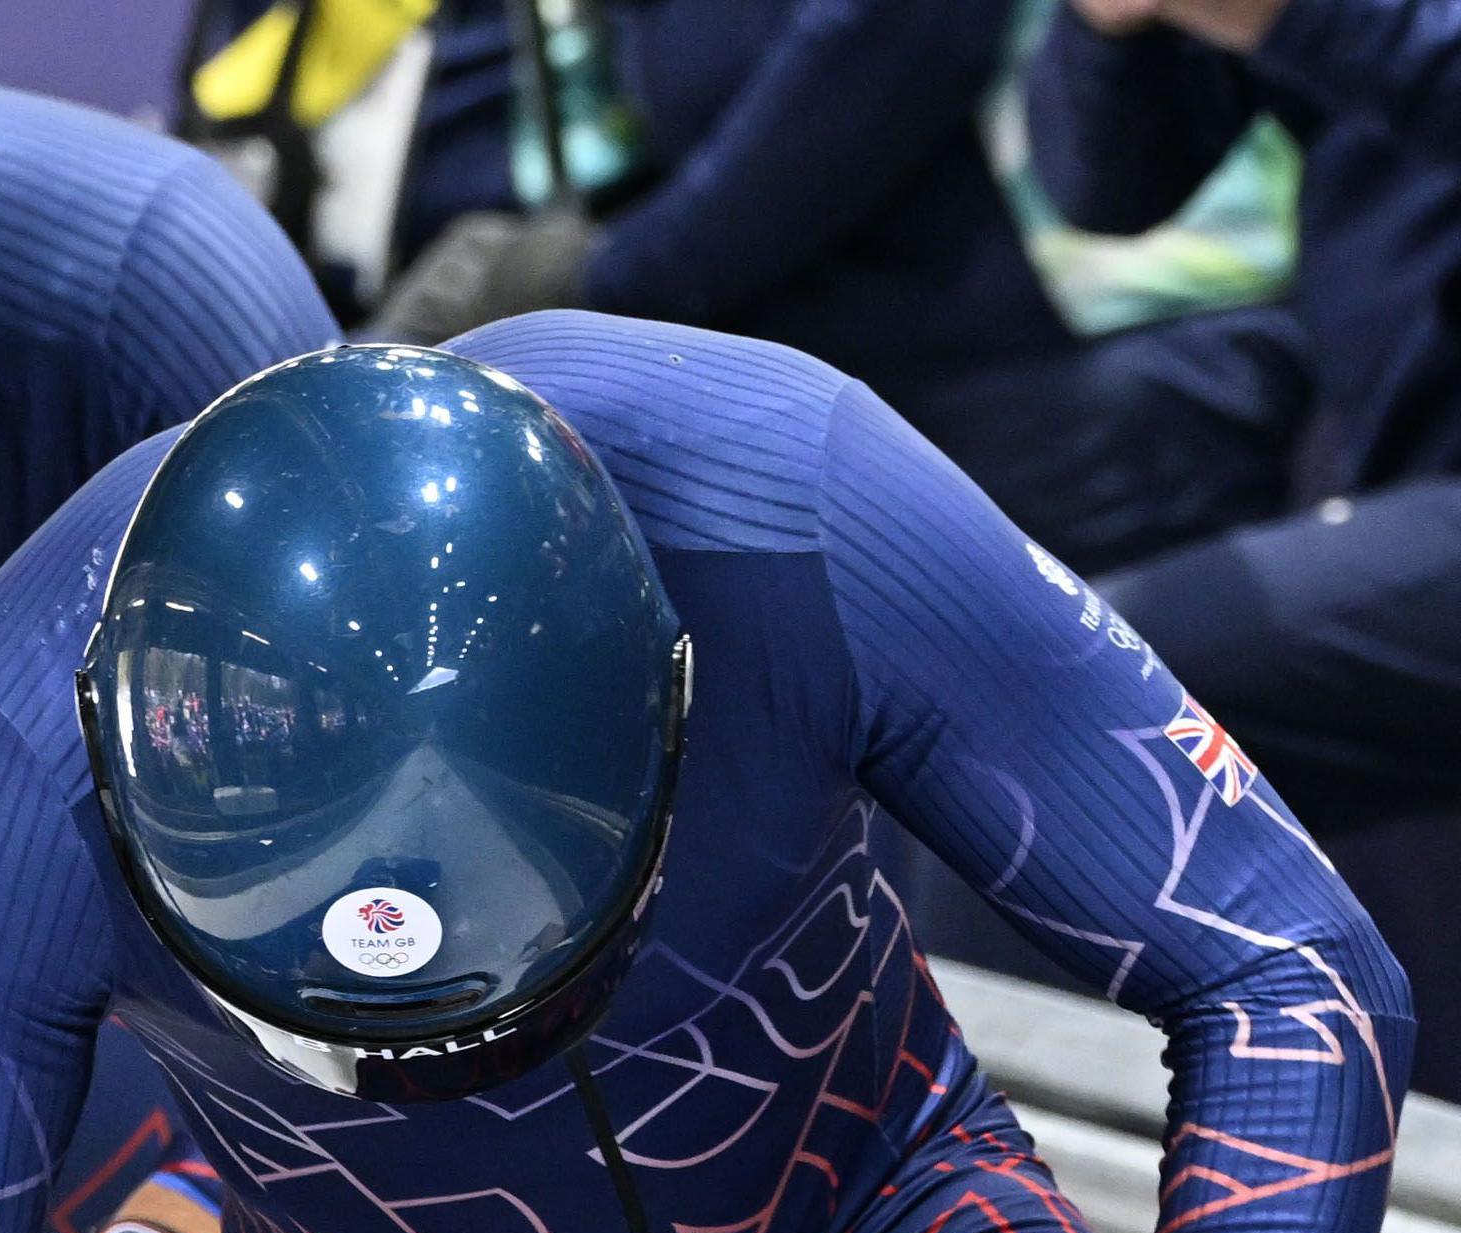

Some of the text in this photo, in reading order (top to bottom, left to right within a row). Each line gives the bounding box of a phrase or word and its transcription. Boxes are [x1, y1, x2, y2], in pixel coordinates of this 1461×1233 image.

[351, 937, 416, 949] TEAM GB
[354, 1027, 518, 1060] HALL
